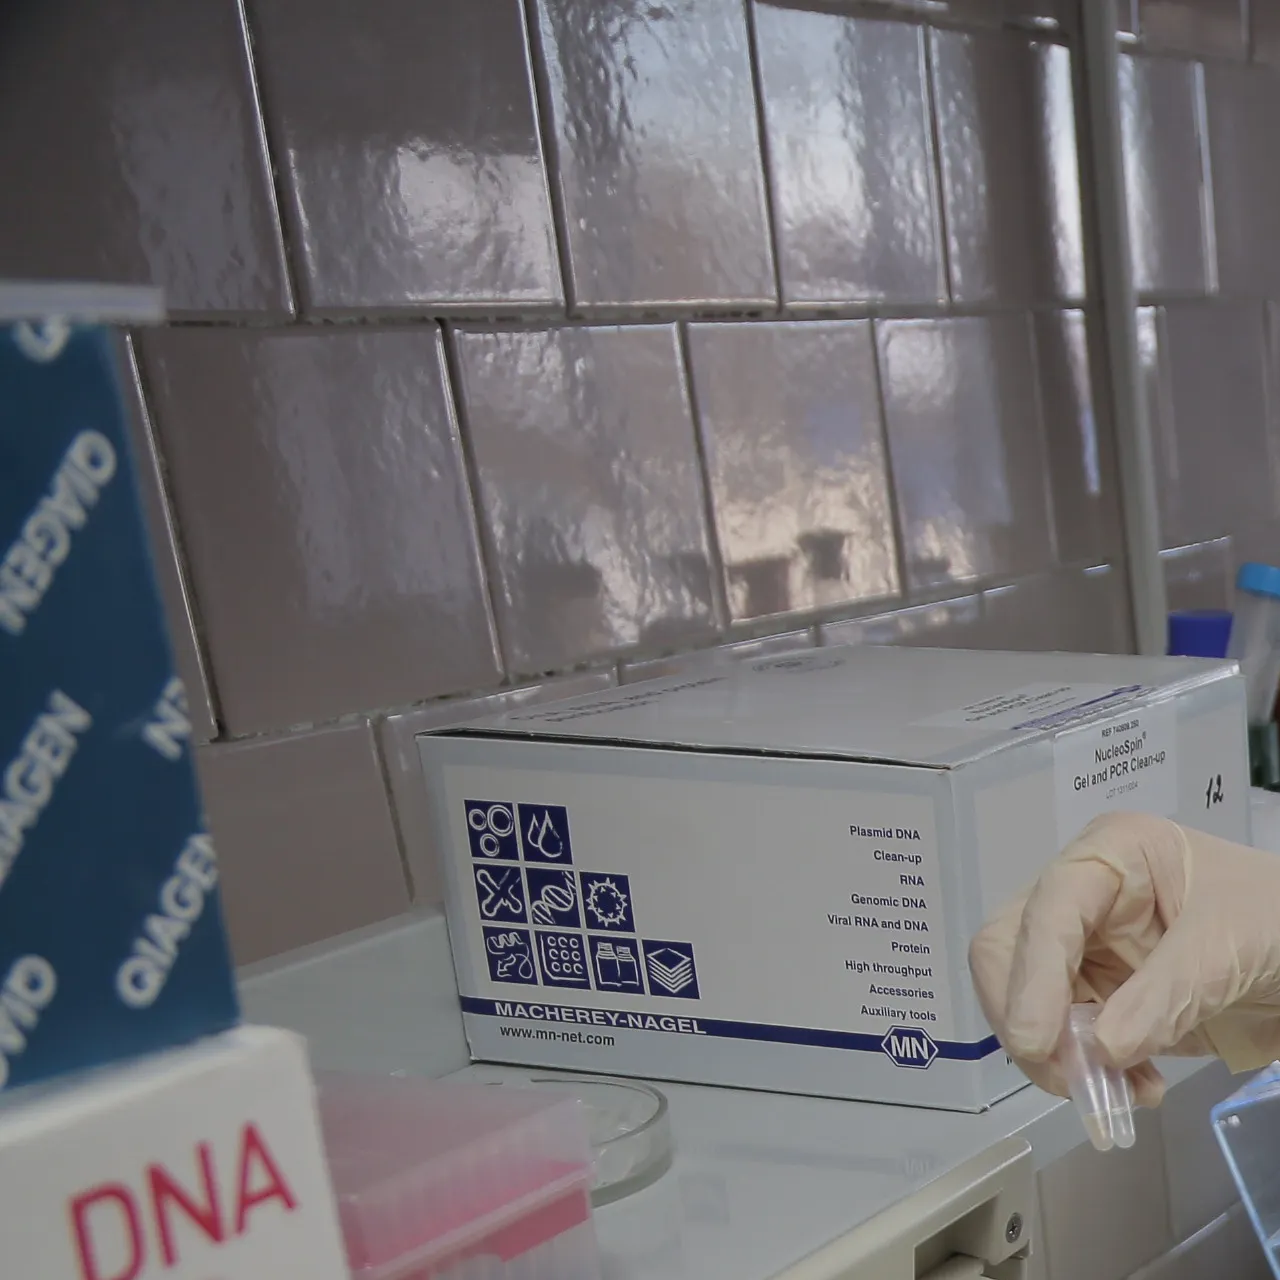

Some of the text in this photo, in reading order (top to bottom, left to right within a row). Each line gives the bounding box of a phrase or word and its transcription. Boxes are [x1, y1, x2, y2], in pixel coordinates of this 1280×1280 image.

[0, 429, 116, 636] QIAGEN
[1073, 750, 1166, 791] Gel and PCR Clean-up
[850, 825, 921, 840] Plasmid DNA
[873, 850, 922, 865] Clean-up
[900, 875, 925, 886] RNA
[851, 894, 927, 909] Genomic DNA
[827, 914, 929, 932] Viral RNA and DNA
[891, 942, 930, 955] Protein
[845, 960, 932, 977] High throughput
[869, 984, 934, 999] Accessories
[494, 1001, 707, 1034] MACHEREY-NAGEL
[861, 1005, 937, 1021] Auxiliary tools
[0, 954, 58, 1090] QIA
[500, 1026, 615, 1046] www.mn-net.com
[890, 1035, 930, 1060] MN
